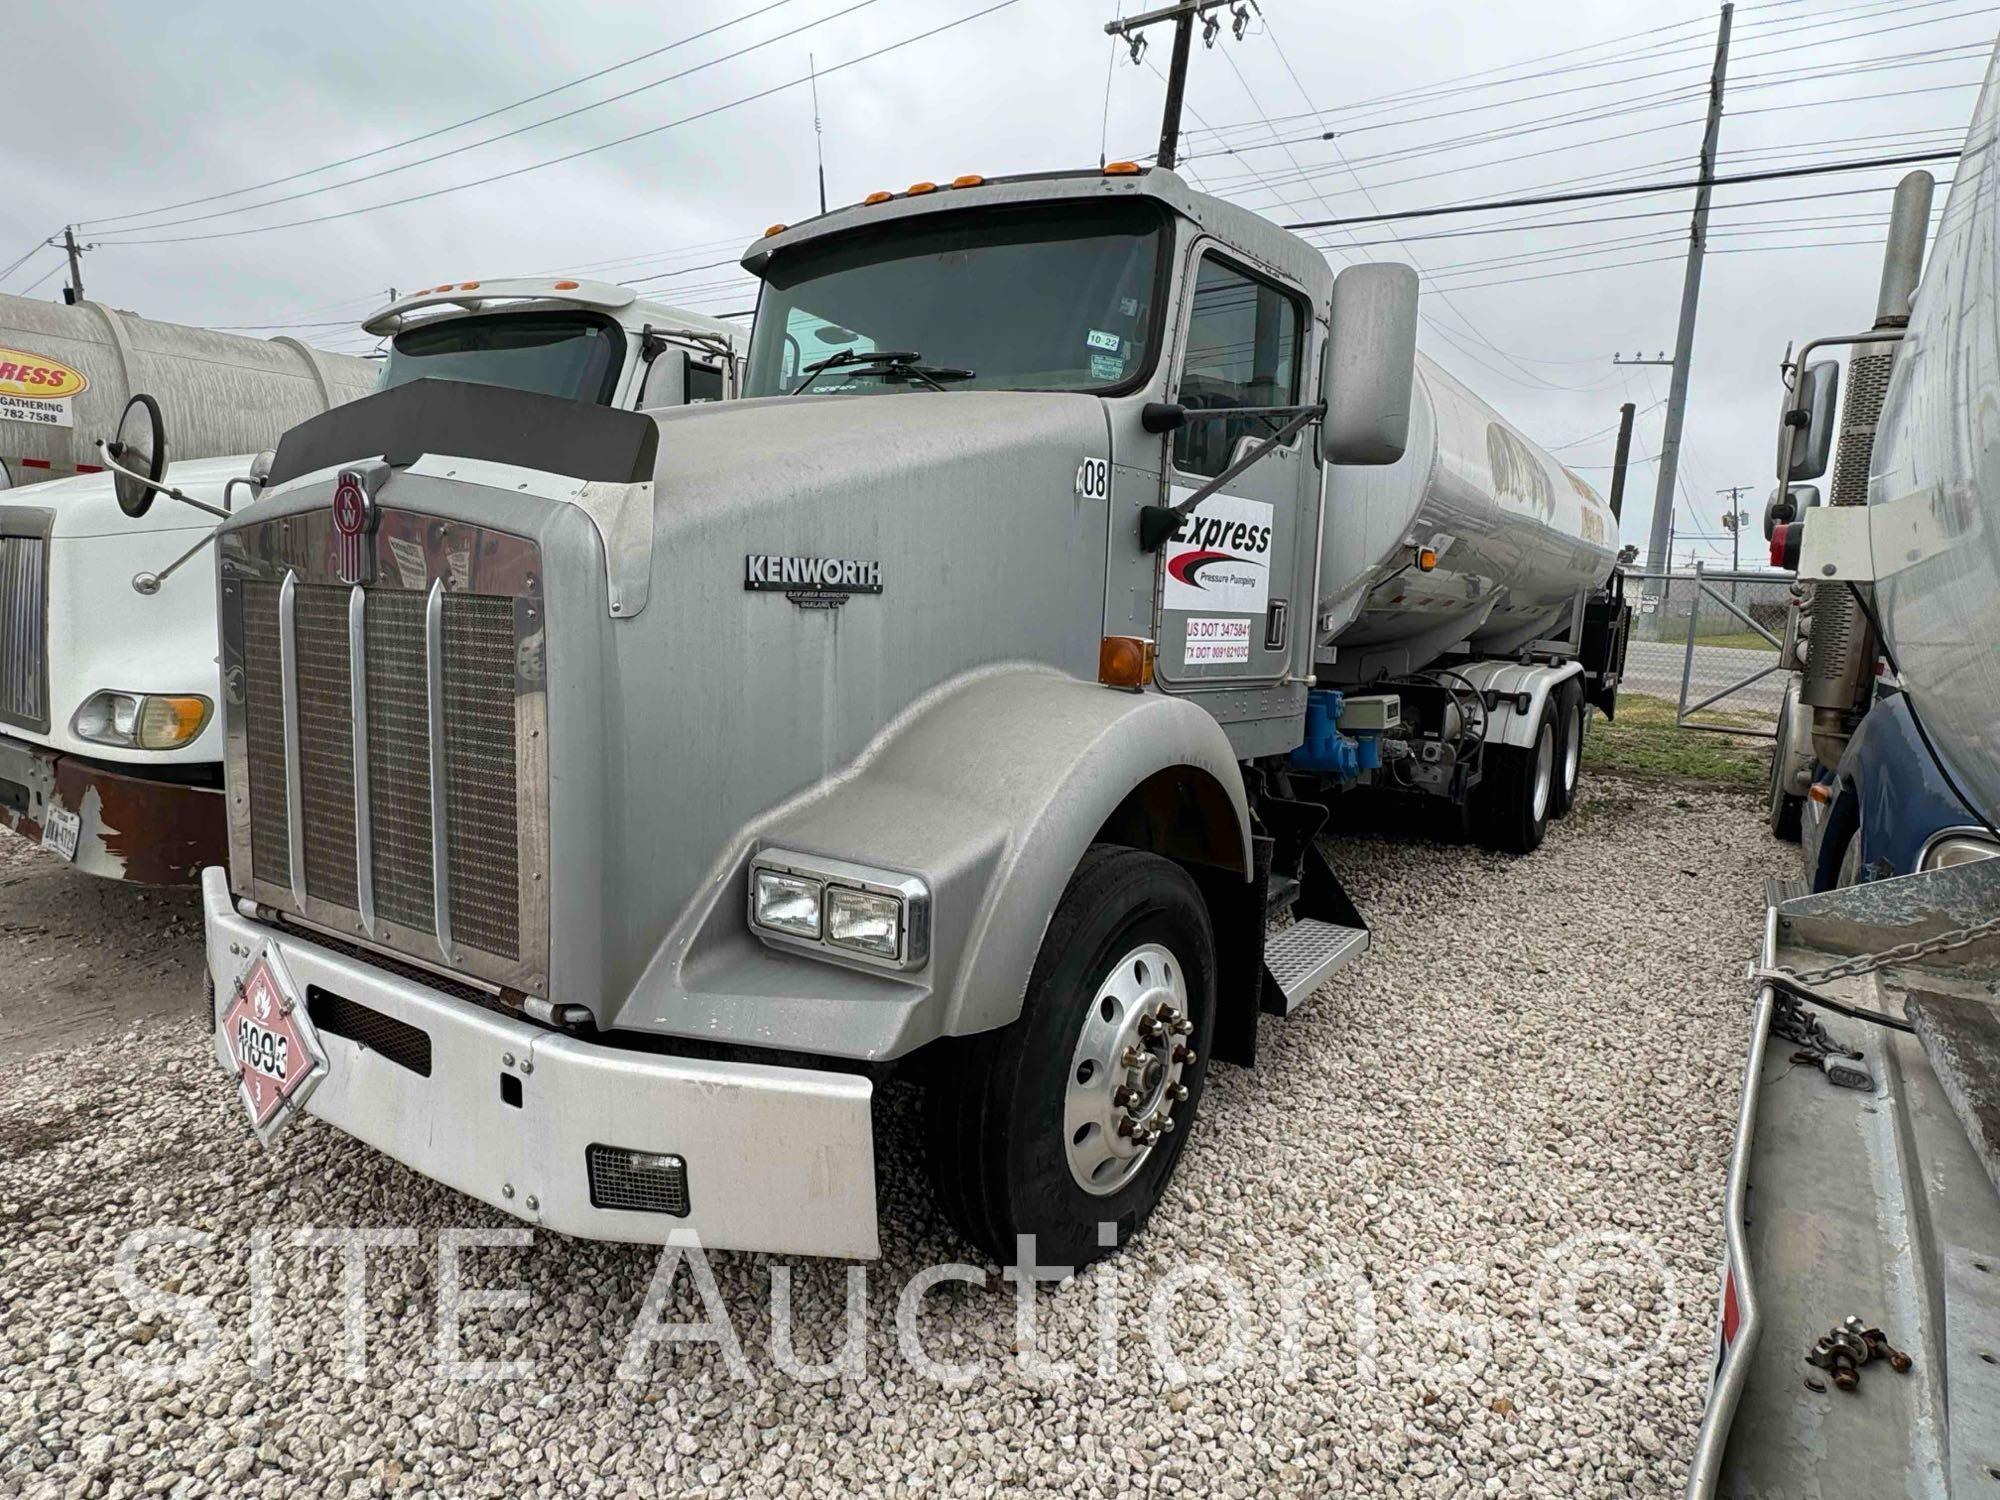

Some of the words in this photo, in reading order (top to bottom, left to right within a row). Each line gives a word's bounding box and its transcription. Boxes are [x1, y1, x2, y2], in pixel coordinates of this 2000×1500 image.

[0, 397, 63, 413] GATHERING
[1084, 460, 1105, 497] 08
[1170, 516, 1271, 553] Express
[747, 555, 882, 585] KENWORTH
[1200, 571, 1229, 583] Pressure
[1230, 574, 1256, 587] Pumping
[1187, 622, 1199, 637] US
[1201, 622, 1219, 637] DOT
[1195, 646, 1211, 659] DOT
